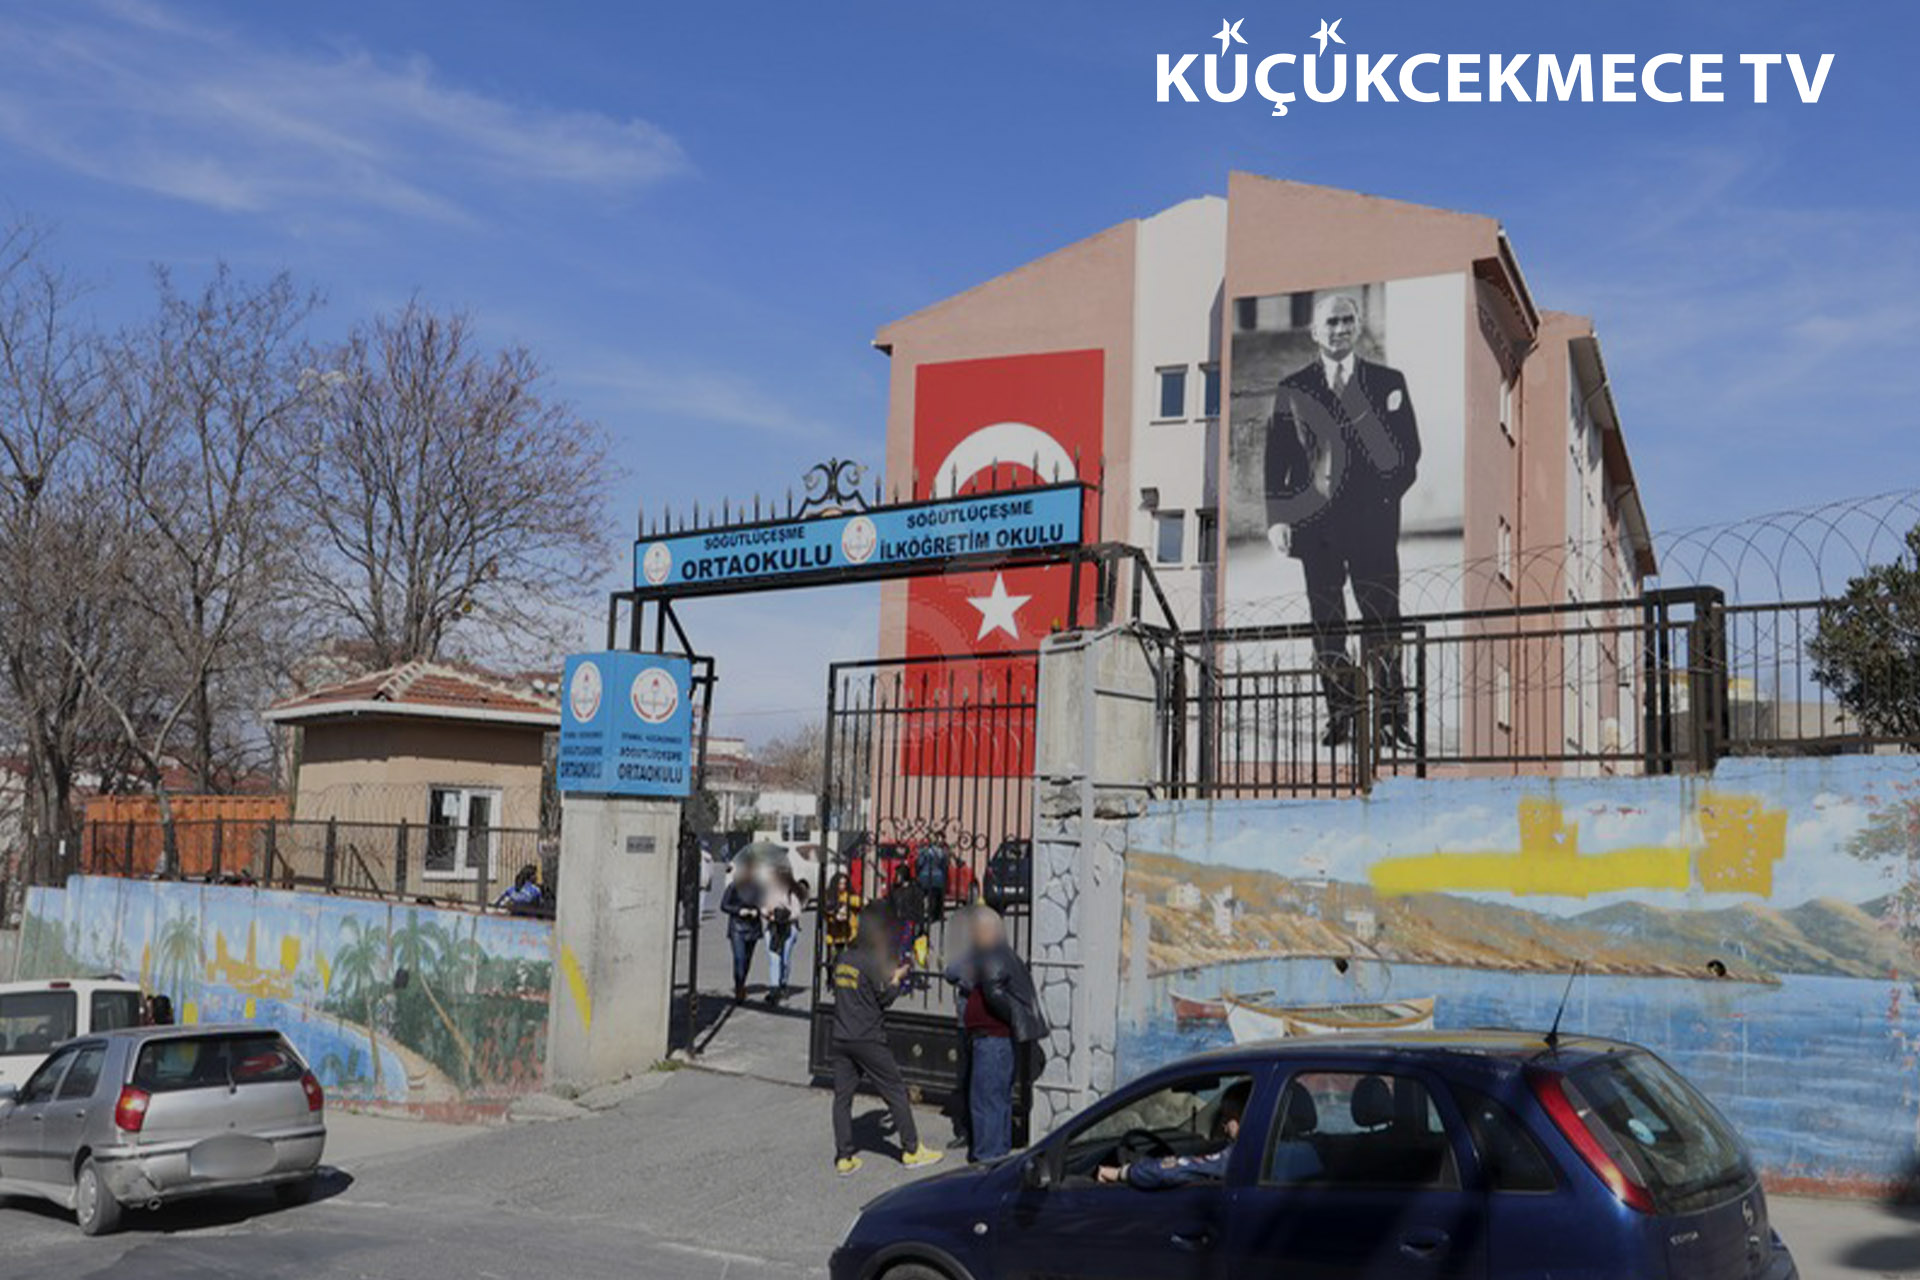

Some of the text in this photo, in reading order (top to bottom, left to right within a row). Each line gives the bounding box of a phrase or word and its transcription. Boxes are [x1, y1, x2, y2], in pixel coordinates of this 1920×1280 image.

[880, 523, 1064, 560] İLKÖĞRETİM OKULU
[681, 544, 832, 580] ORTAOKULU
